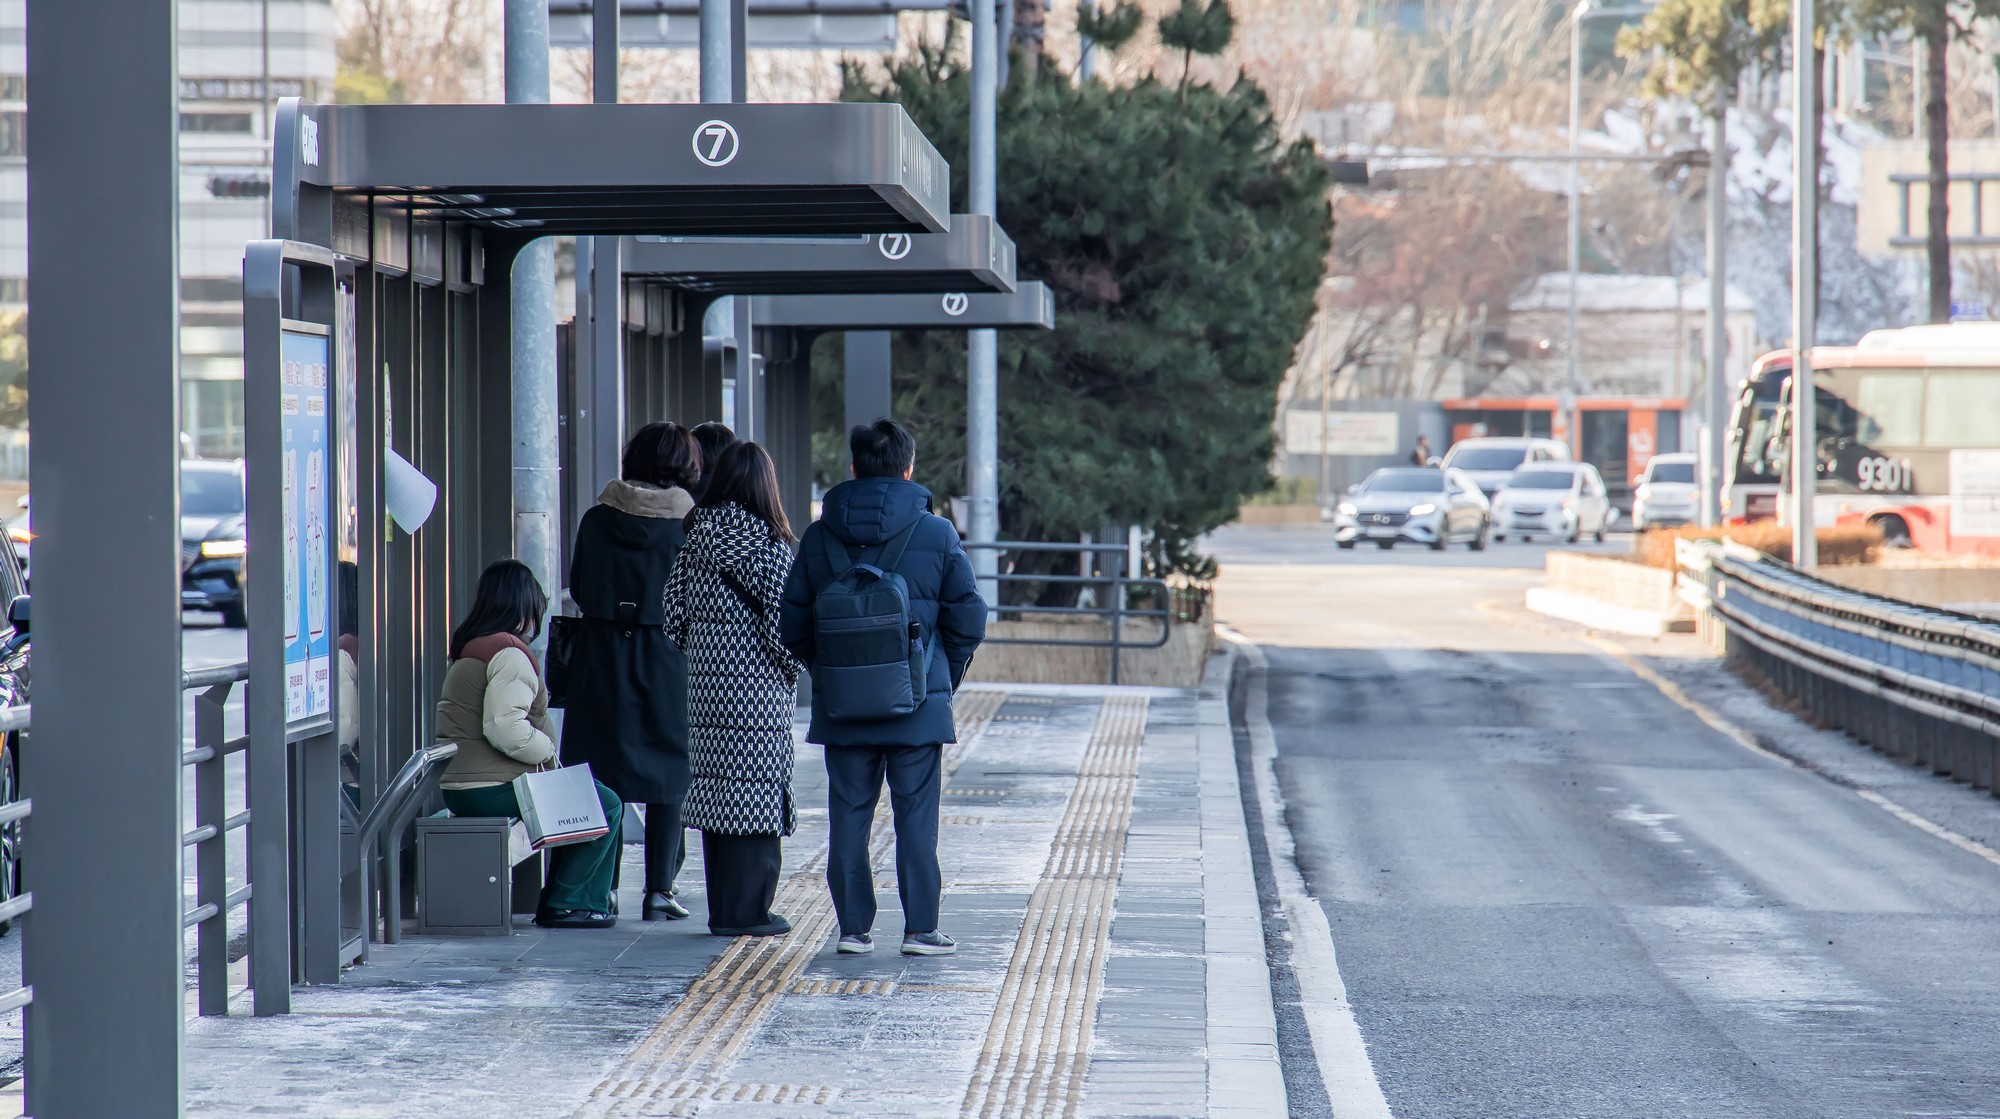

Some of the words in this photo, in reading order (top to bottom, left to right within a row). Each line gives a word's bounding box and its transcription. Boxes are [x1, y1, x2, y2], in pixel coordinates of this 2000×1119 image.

[706, 128, 727, 160] 7
[1857, 456, 1911, 491] 9301
[557, 815, 590, 827] POLHAM
